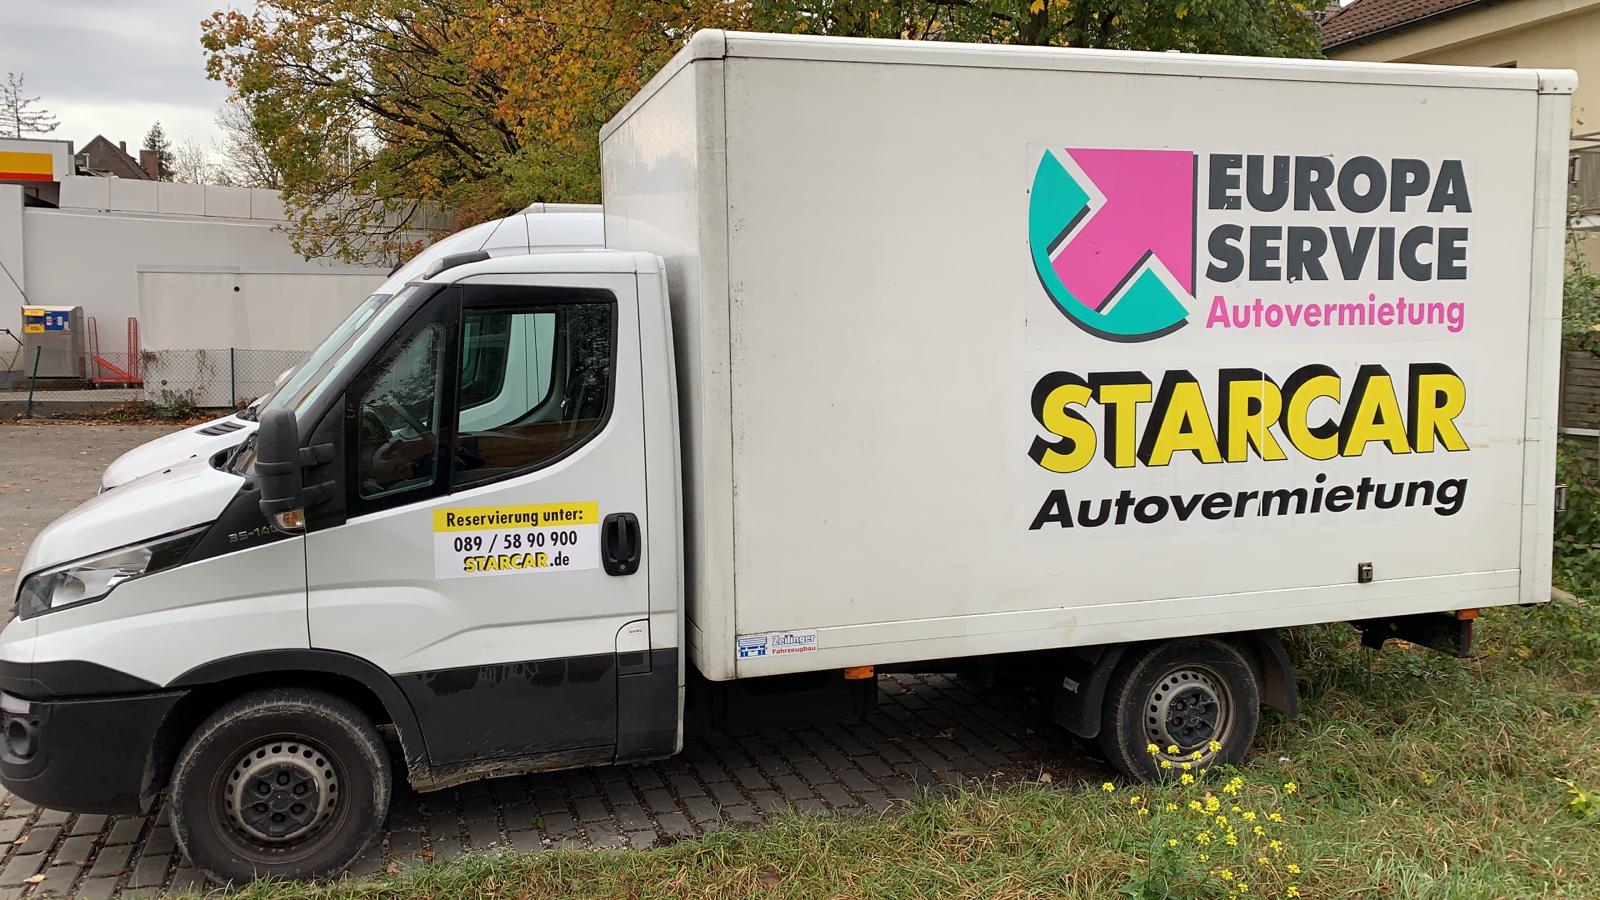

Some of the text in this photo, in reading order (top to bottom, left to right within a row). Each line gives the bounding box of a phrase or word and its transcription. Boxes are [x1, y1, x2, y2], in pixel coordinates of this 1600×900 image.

[1207, 153, 1472, 213] EUROPA
[1205, 223, 1469, 283] SERVICE
[1205, 293, 1465, 333] Autovermietung
[1027, 362, 1470, 474] STARCAR
[446, 509, 583, 527] Reservierung unter:
[1028, 473, 1468, 531] Autovermietung
[454, 530, 577, 553] 089 / 58 90 900
[771, 634, 816, 646] Zeilinger
[772, 646, 816, 654] Fahrzeugbau
